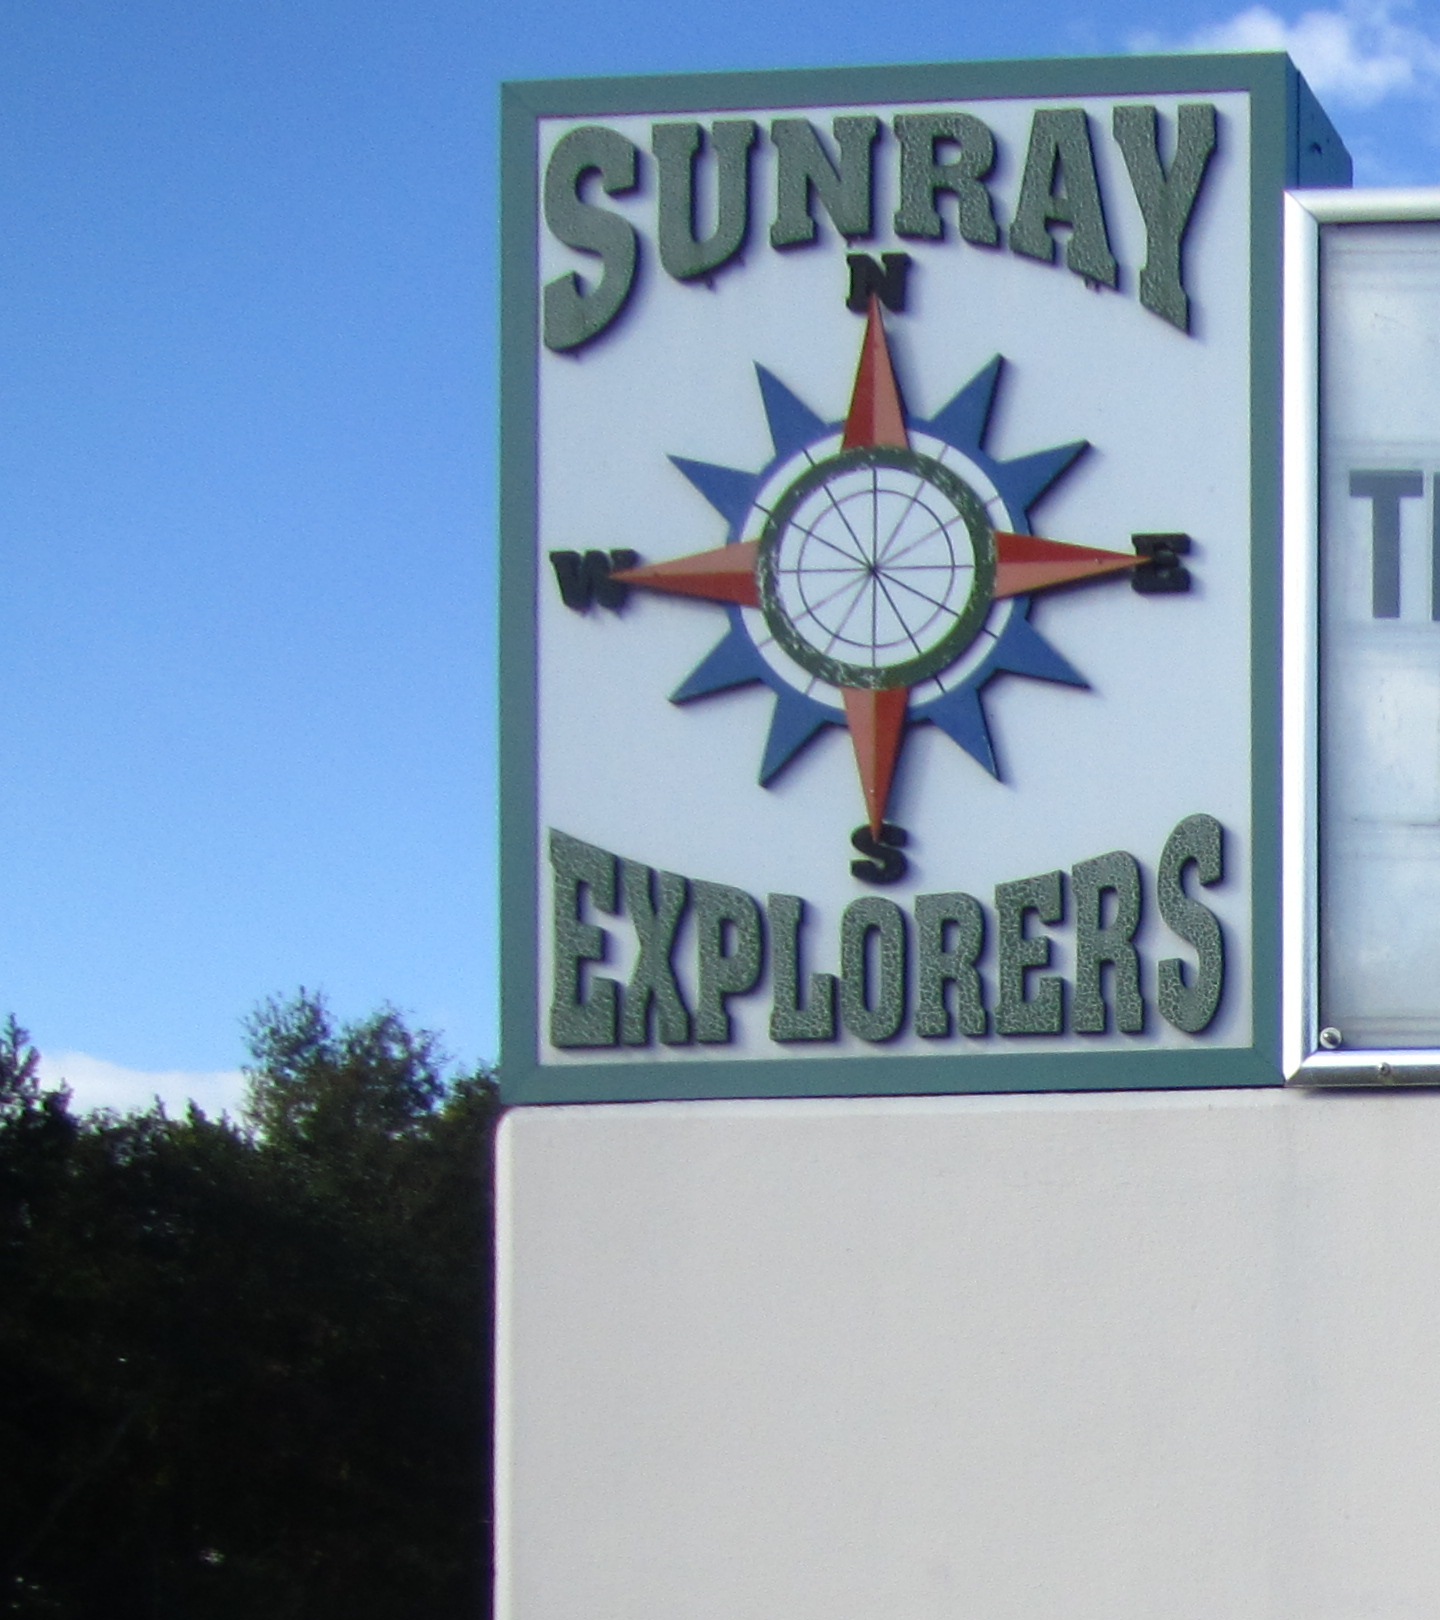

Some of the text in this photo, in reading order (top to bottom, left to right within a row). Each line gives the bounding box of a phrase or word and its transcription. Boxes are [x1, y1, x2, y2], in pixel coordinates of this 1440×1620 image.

[543, 103, 1216, 354] SUNRAY
[847, 253, 908, 312] N
[549, 549, 638, 612] W
[1130, 533, 1192, 594] E
[851, 822, 908, 884] S
[549, 814, 1224, 1048] EXPLORERS
